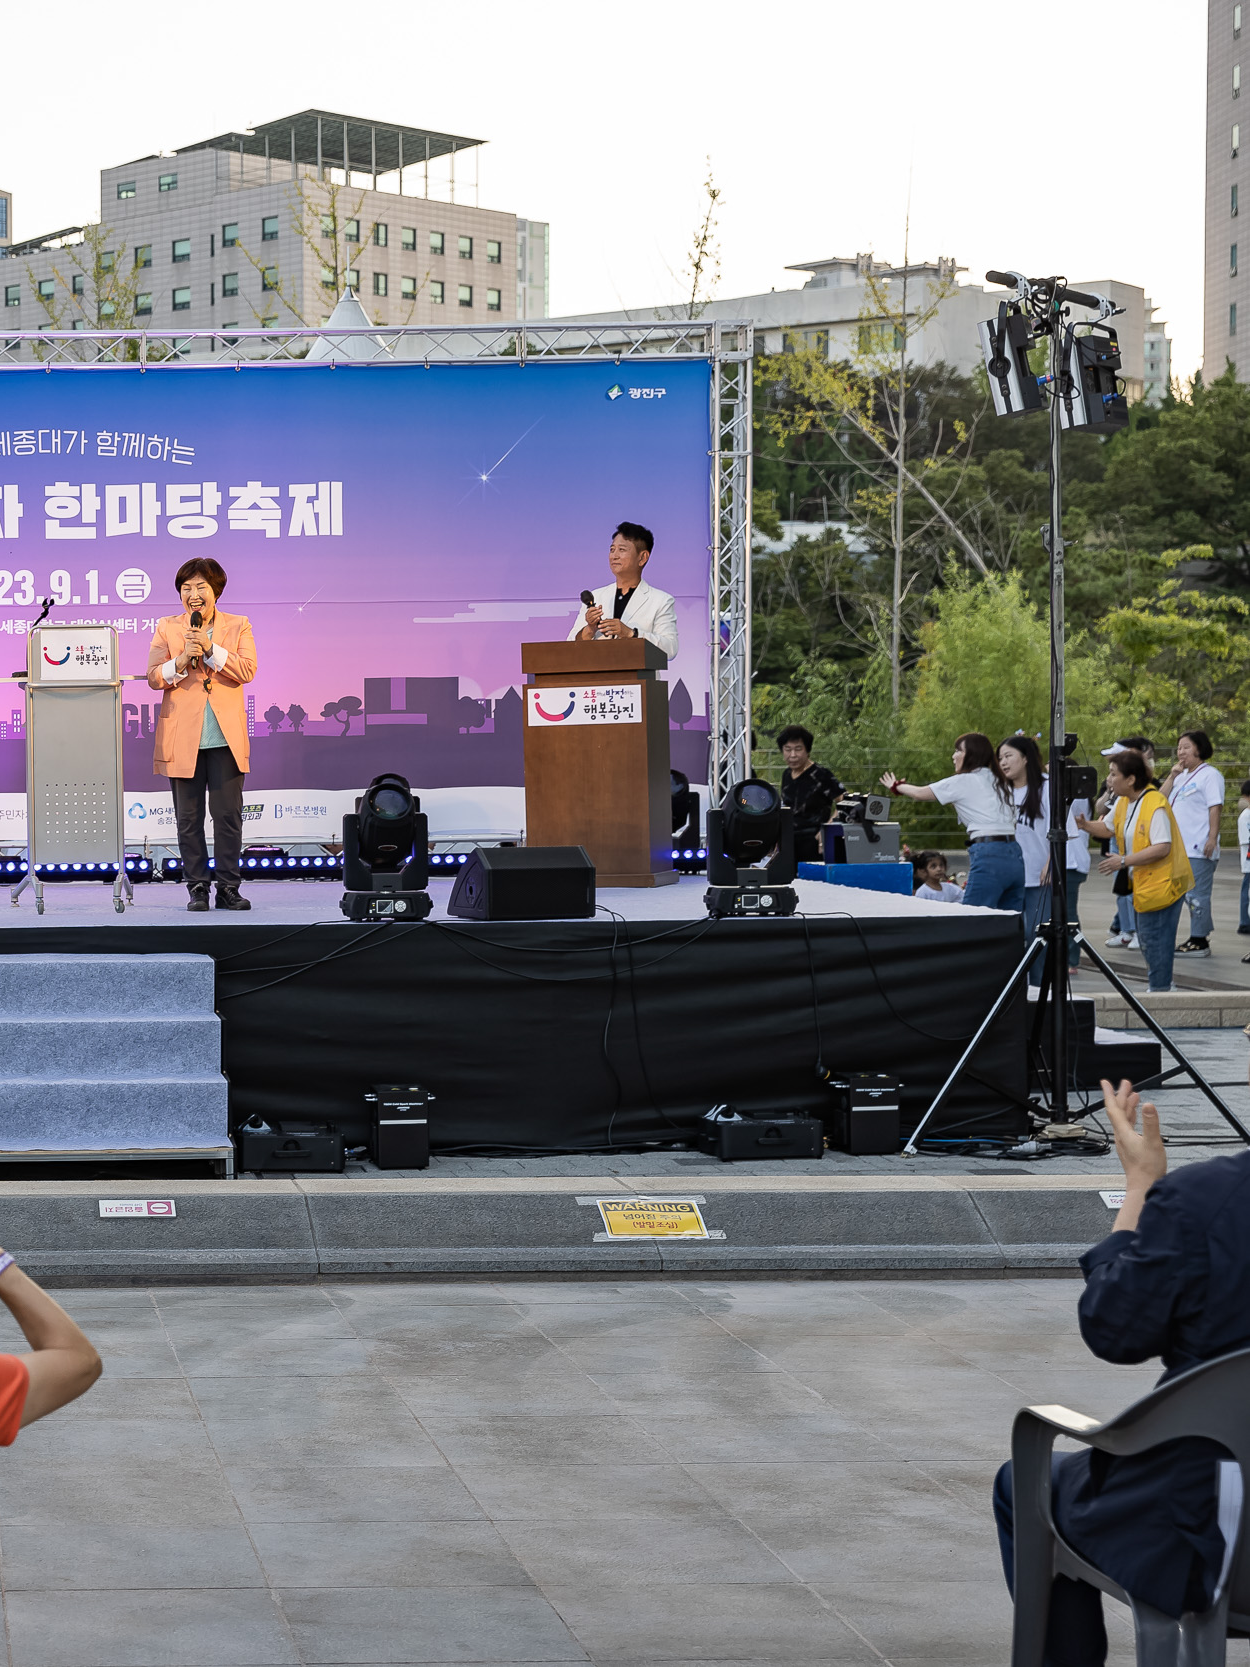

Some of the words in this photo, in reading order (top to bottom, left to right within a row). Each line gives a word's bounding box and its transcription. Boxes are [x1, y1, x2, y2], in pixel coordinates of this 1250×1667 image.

[628, 387, 667, 399] 광진구
[96, 430, 196, 466] 함께하는
[43, 481, 344, 540] 한마당축제
[141, 618, 160, 634] 거
[75, 653, 108, 665] 행복광진
[583, 702, 634, 720] 행복광진
[285, 805, 327, 815] 바른본병원
[606, 1203, 690, 1212] WARNING
